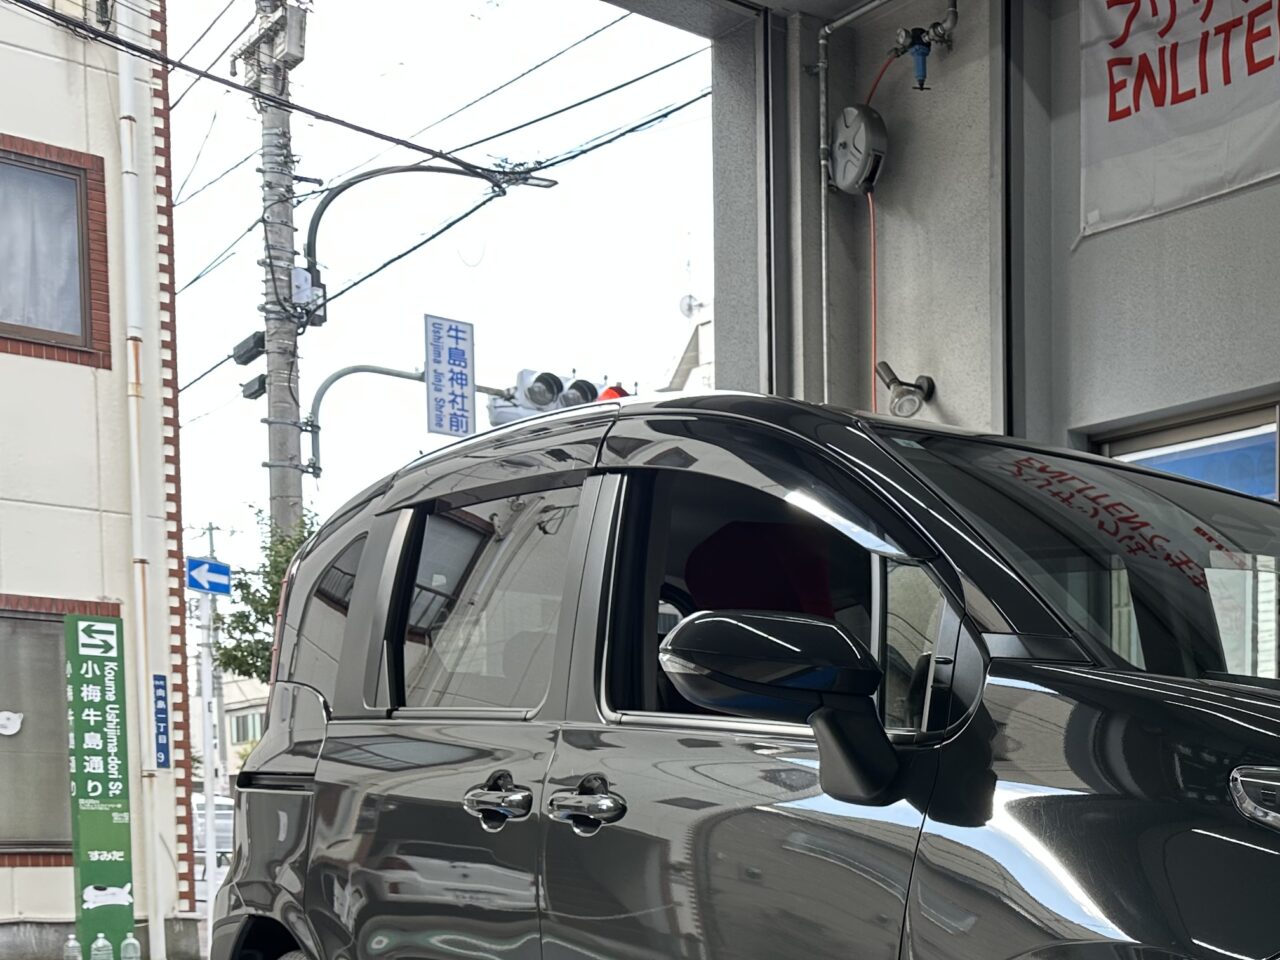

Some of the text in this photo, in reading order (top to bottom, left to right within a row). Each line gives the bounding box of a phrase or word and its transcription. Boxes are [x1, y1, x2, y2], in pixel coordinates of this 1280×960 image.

[430, 322, 446, 428] Ushijima Jinja Shrine
[447, 324, 469, 433] 牛島神社前
[103, 661, 118, 701] Koume
[80, 660, 105, 796] 小梅牛島通り
[103, 704, 122, 778] Ushijima-dori
[157, 752, 165, 763] 9
